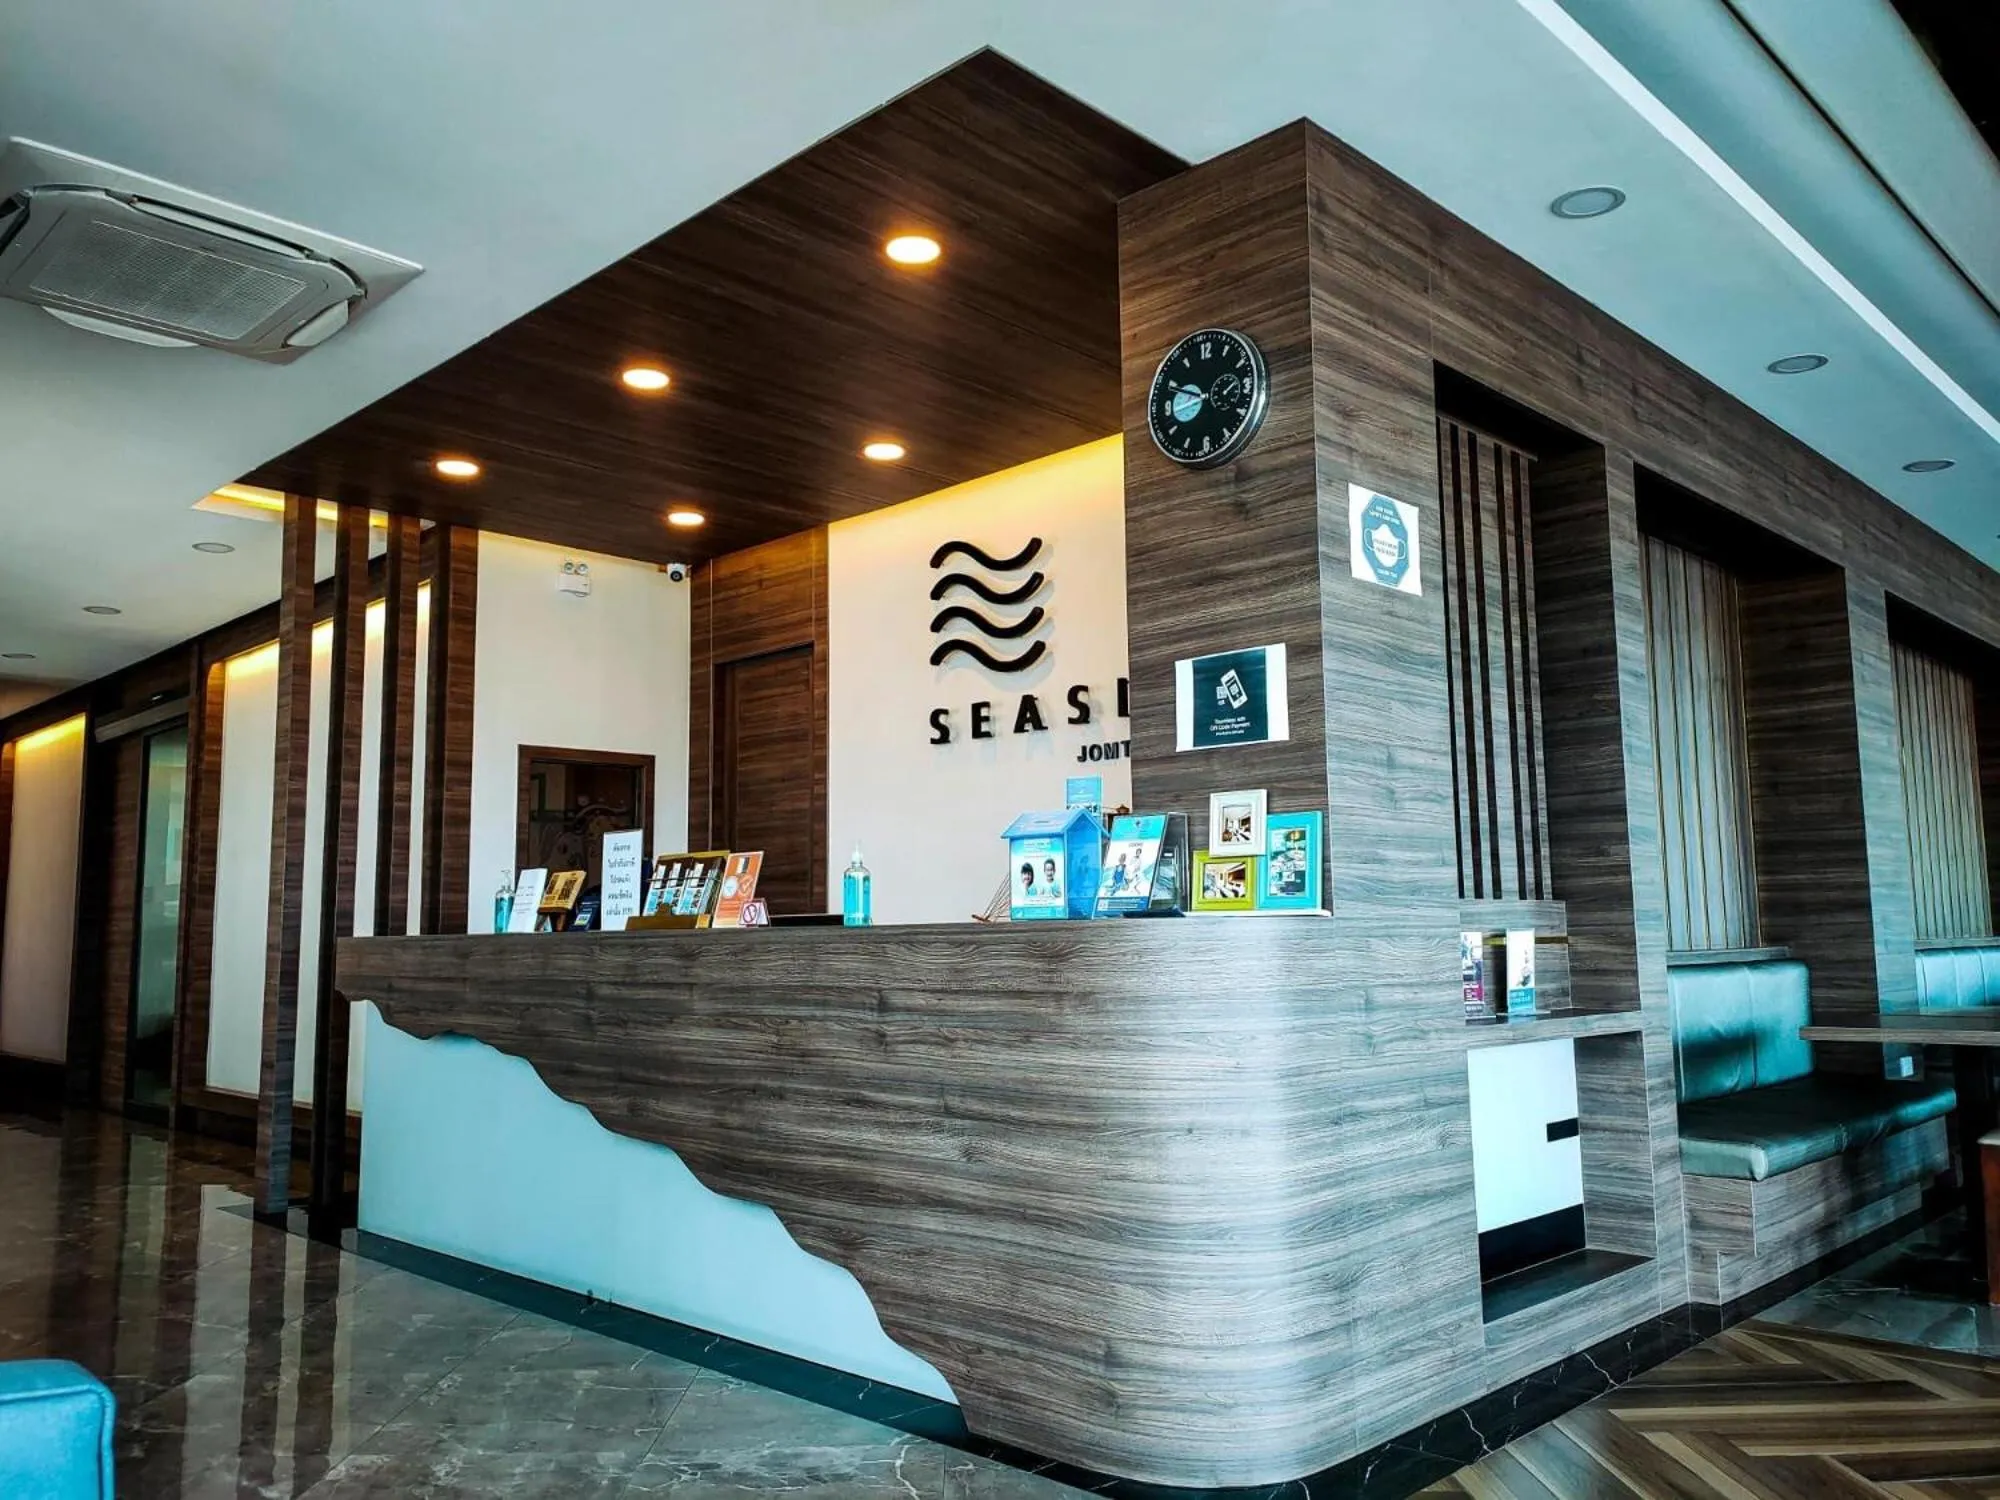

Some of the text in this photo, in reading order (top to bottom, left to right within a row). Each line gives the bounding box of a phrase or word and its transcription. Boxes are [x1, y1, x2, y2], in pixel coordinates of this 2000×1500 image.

[1200, 341, 1212, 360] 12
[1243, 377, 1252, 394] 3
[1164, 400, 1172, 416] 9
[1202, 435, 1210, 453] 6
[1077, 739, 1131, 763] JOMT
